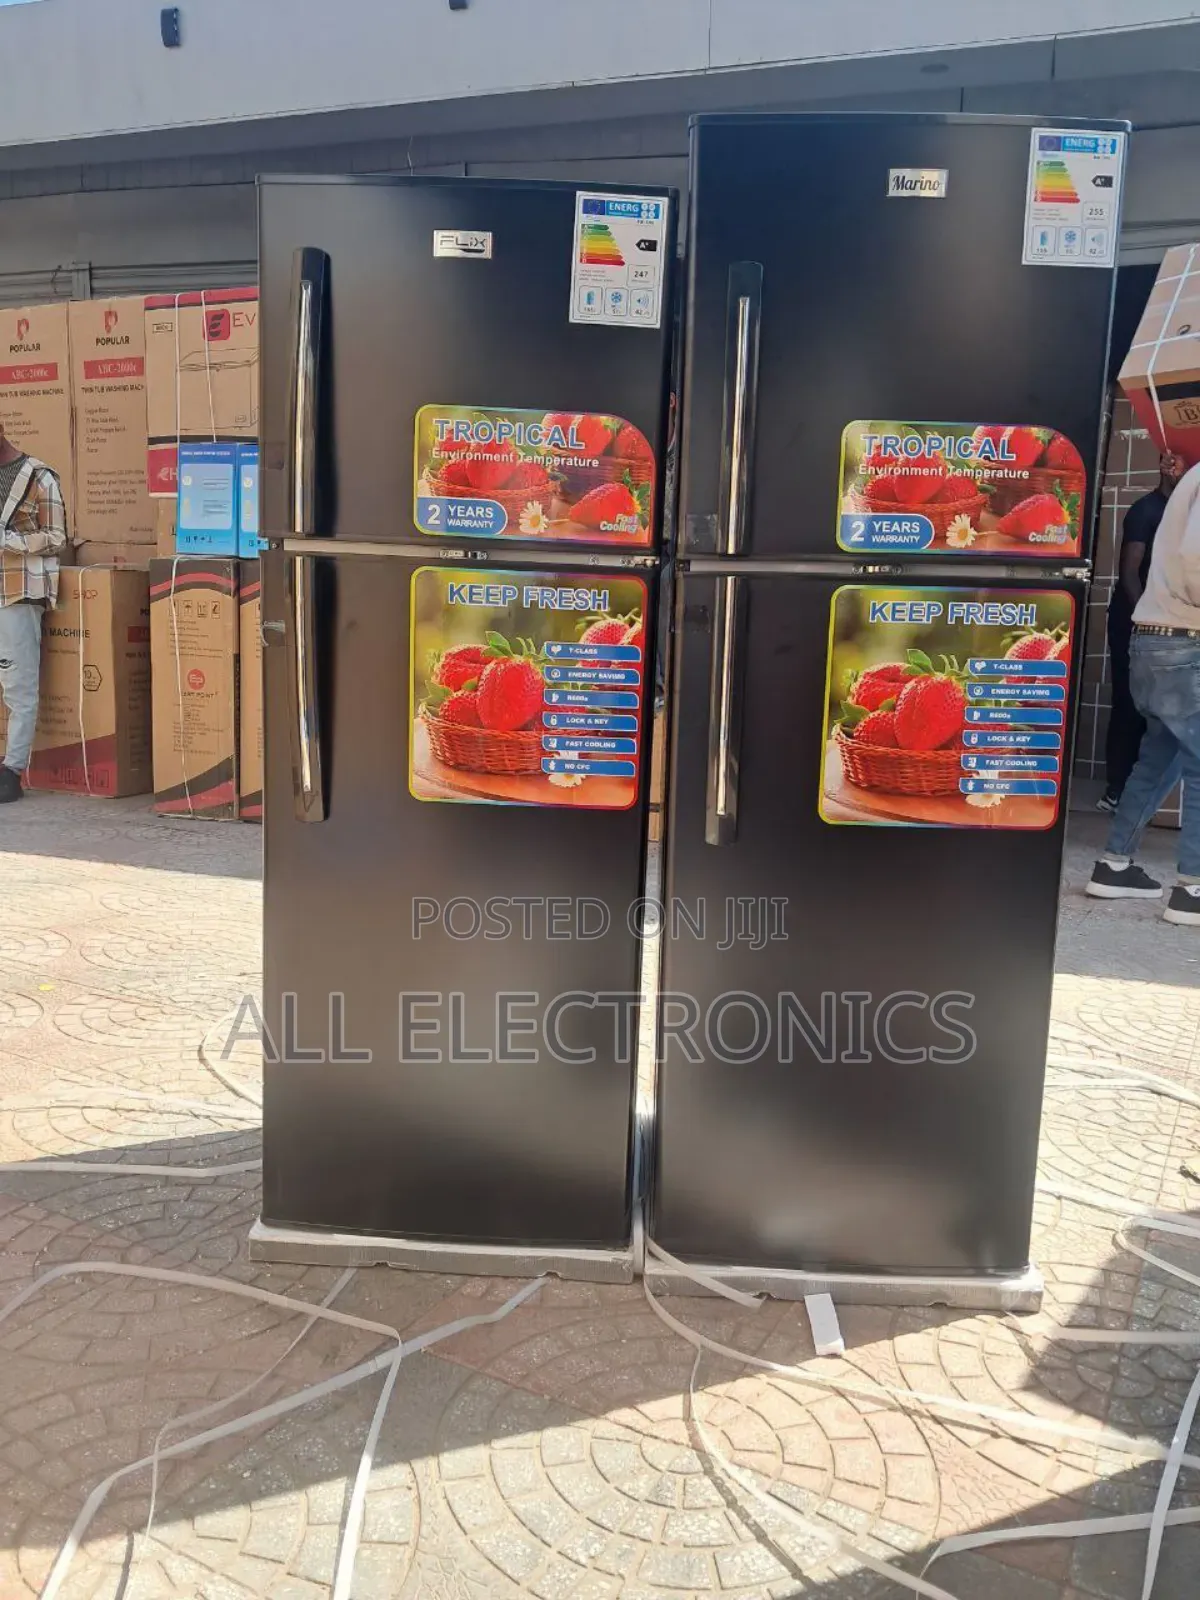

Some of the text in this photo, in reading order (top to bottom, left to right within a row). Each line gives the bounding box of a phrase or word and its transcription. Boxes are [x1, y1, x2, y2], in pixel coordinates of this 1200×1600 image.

[892, 174, 940, 191] Marino
[609, 202, 640, 212] ENERG
[1089, 208, 1104, 216] 255
[634, 270, 649, 278] 247
[9, 343, 41, 353] POPULAR
[96, 336, 130, 346] POPULAR
[434, 418, 586, 450] TROPICAL
[862, 434, 1017, 460] TROPICAL
[432, 450, 600, 468] Environment Temperature
[859, 464, 1030, 480] Environment Temperature
[427, 504, 494, 525] 2 YEARS
[615, 513, 637, 524] Fast
[447, 518, 496, 529] WARRANTY
[600, 520, 638, 535] Cooling
[1045, 524, 1068, 534] Fast
[850, 520, 920, 542] 2 YEARS
[1029, 531, 1066, 545] Cooling
[872, 534, 921, 544] WARRANTY
[448, 582, 610, 612] KEEP FRESH
[870, 600, 1037, 626] KEEP FRESH
[993, 663, 1023, 671] T-CLASS
